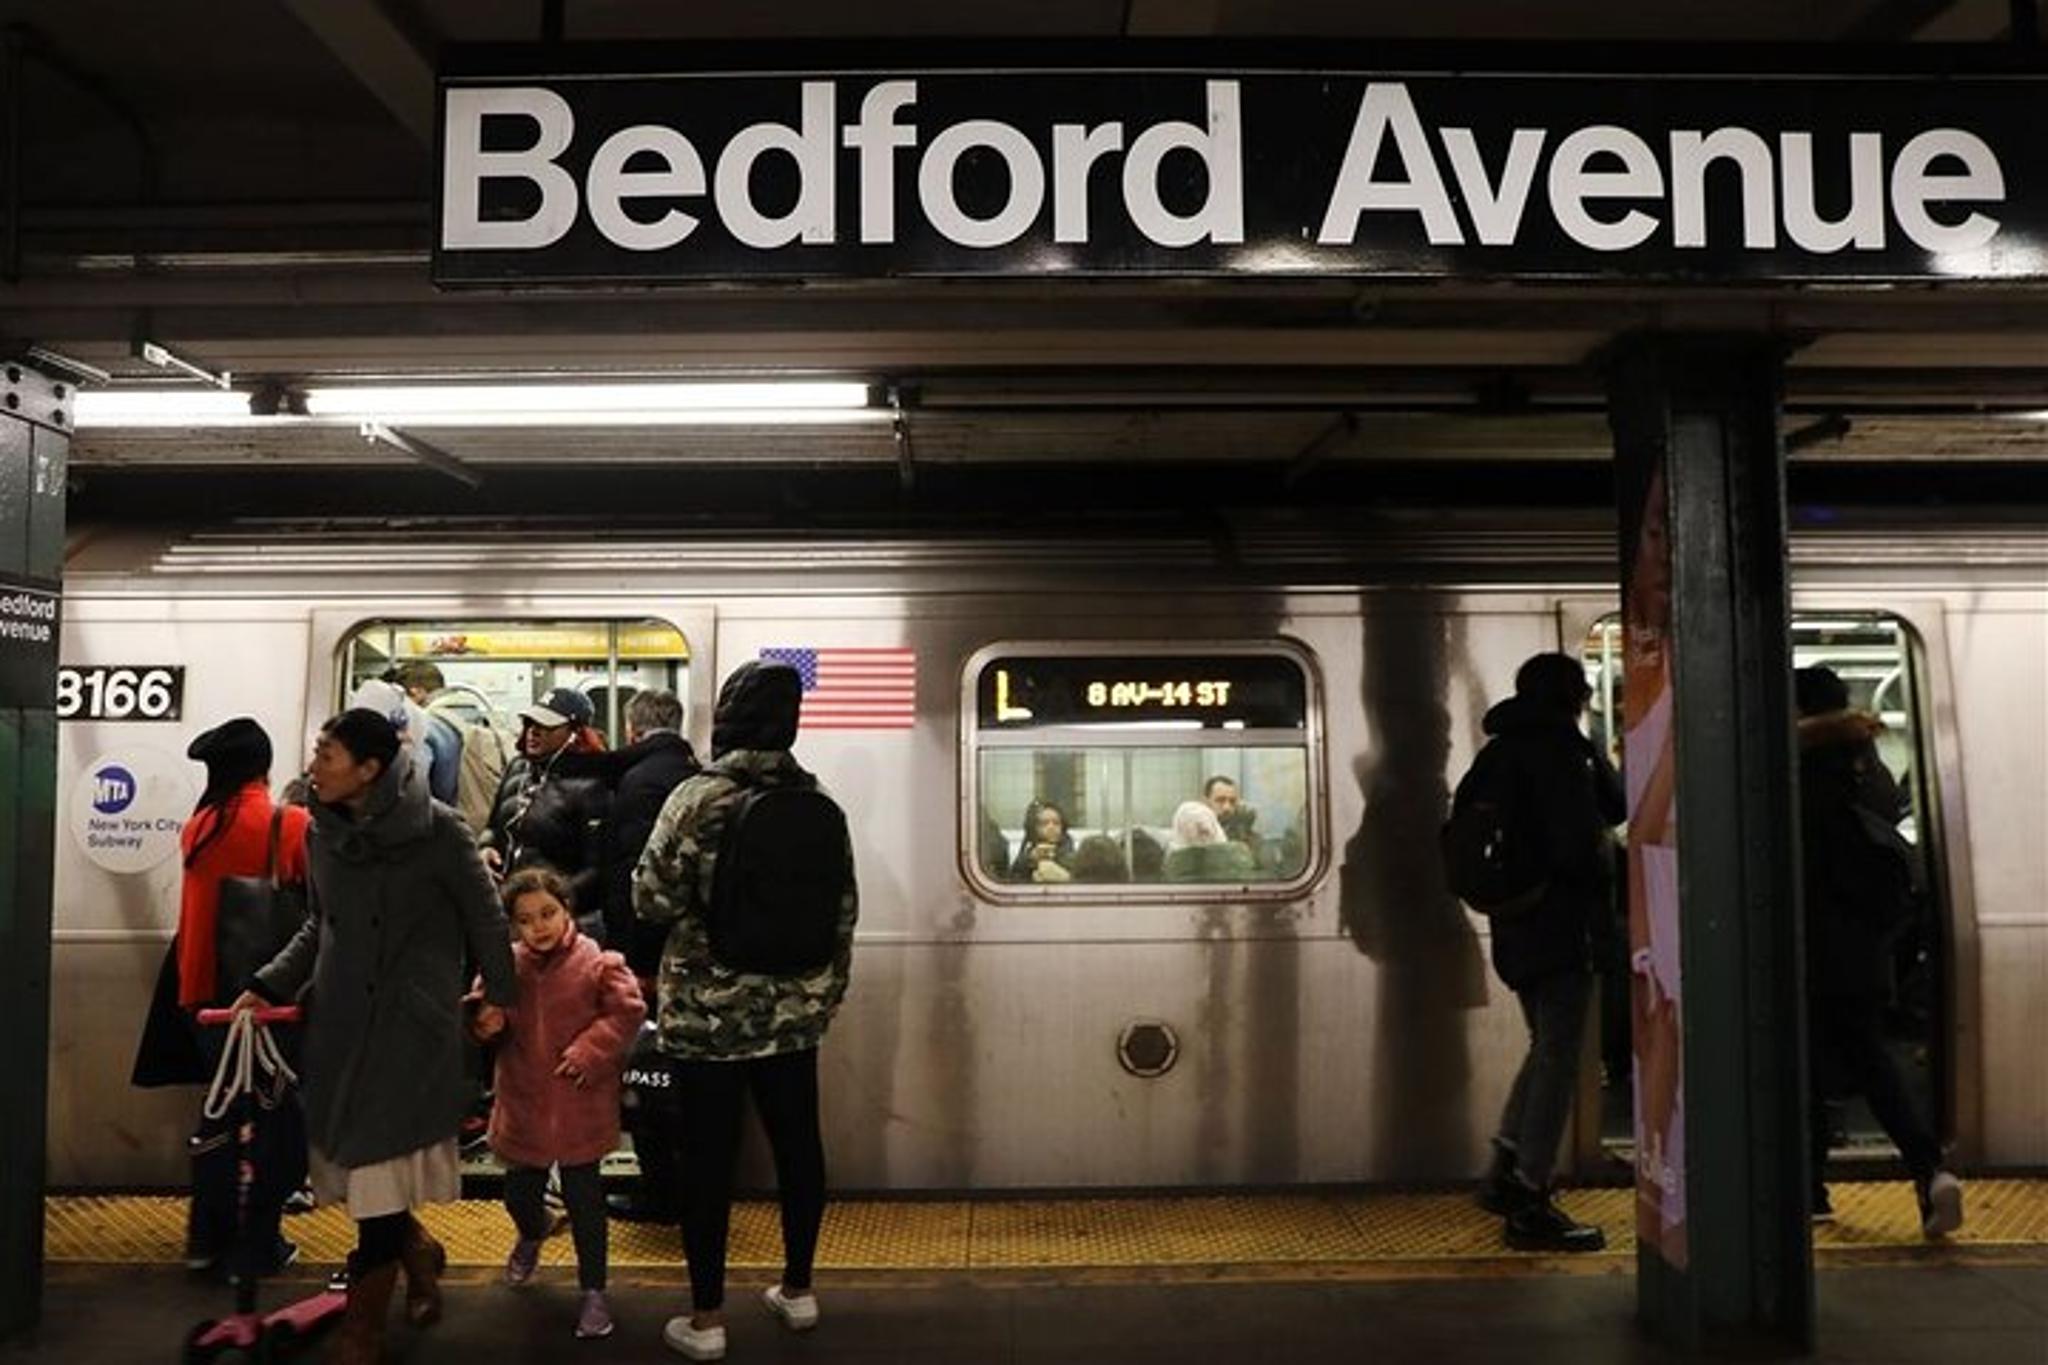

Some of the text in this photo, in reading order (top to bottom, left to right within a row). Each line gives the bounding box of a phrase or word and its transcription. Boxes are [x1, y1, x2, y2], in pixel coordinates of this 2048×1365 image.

[442, 80, 2007, 253] Bedford Avenue
[0, 594, 55, 619] edford
[0, 620, 50, 641] venue
[57, 670, 173, 717] 8166
[997, 670, 1033, 721] L
[1088, 682, 1230, 706] 8 AV-14 ST
[91, 777, 129, 804] MTA
[88, 818, 182, 834] New York City
[87, 833, 142, 850] Subway
